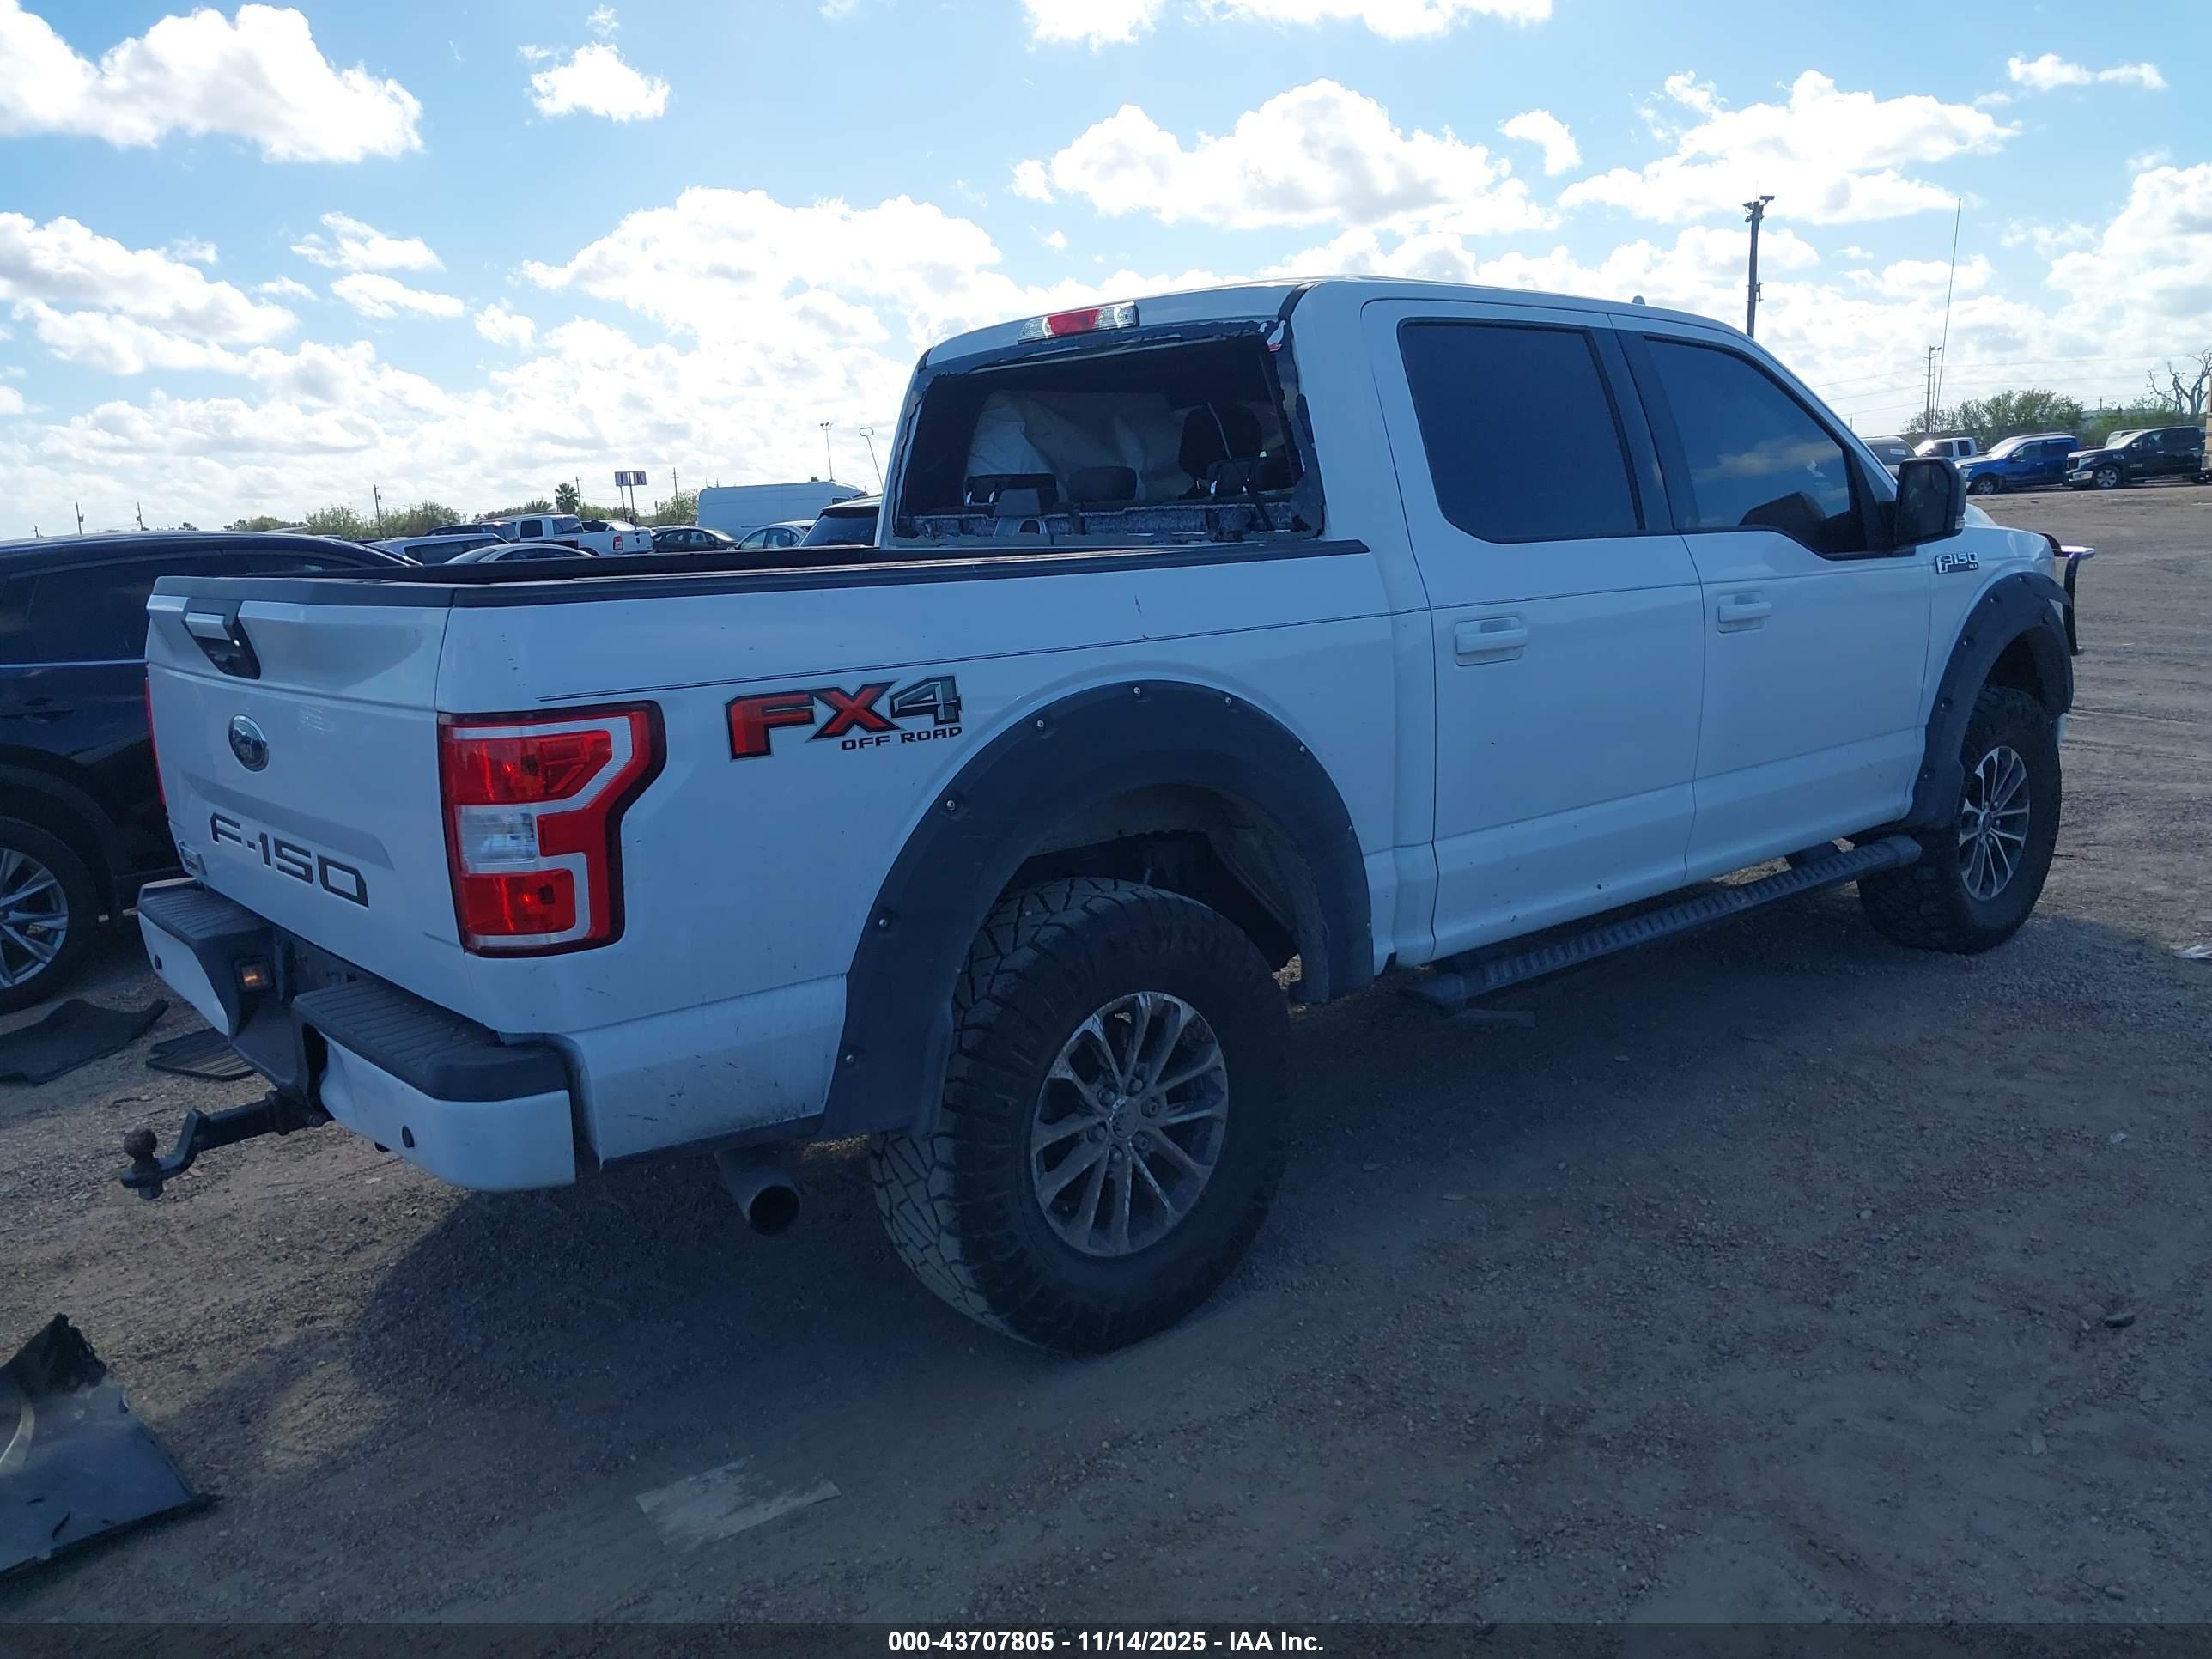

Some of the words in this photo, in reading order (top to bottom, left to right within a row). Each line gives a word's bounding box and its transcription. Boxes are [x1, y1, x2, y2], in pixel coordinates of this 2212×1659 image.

[636, 472, 643, 484] K
[724, 673, 962, 761] FX4
[841, 735, 890, 751] OFF
[900, 726, 963, 745] ROAD
[210, 812, 369, 908] F-150
